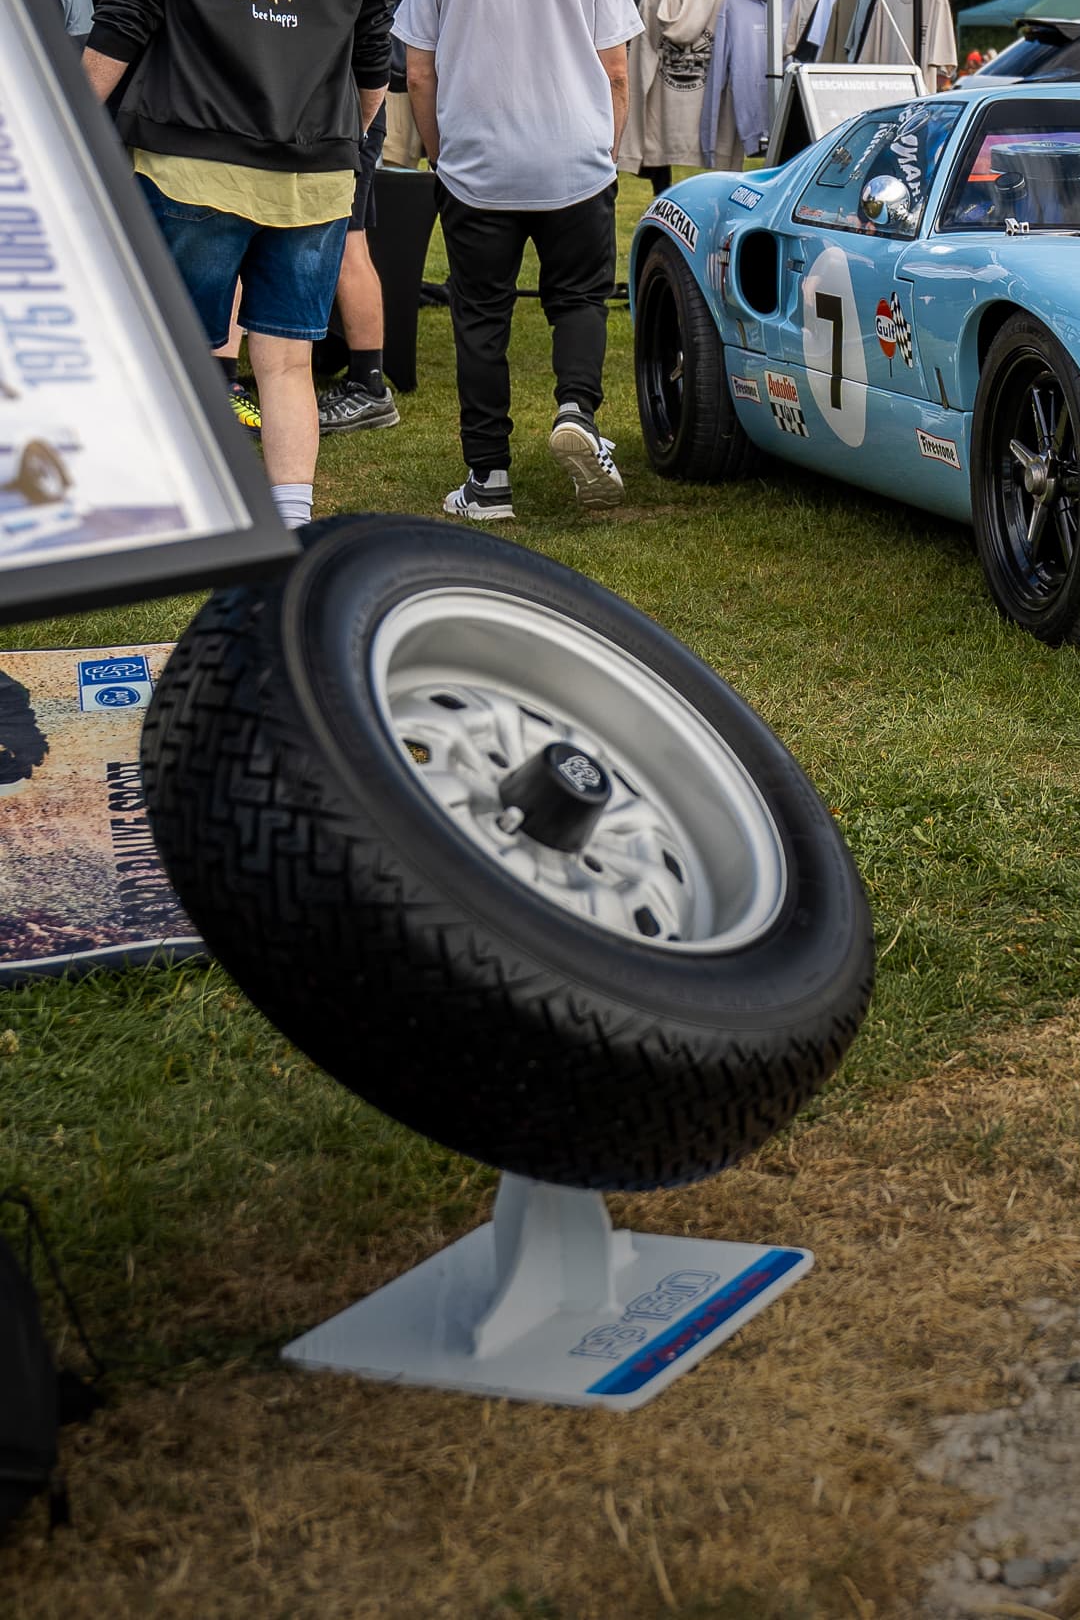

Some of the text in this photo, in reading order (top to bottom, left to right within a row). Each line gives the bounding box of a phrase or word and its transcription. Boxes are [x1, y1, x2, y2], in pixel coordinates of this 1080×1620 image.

[252, 3, 298, 27] bee happy
[653, 199, 697, 247] MARCHAL
[876, 317, 896, 340] Gulf
[3, 302, 98, 390] 1975
[815, 291, 843, 411] 7
[767, 372, 798, 403] Autolite
[919, 434, 956, 461] Firestone
